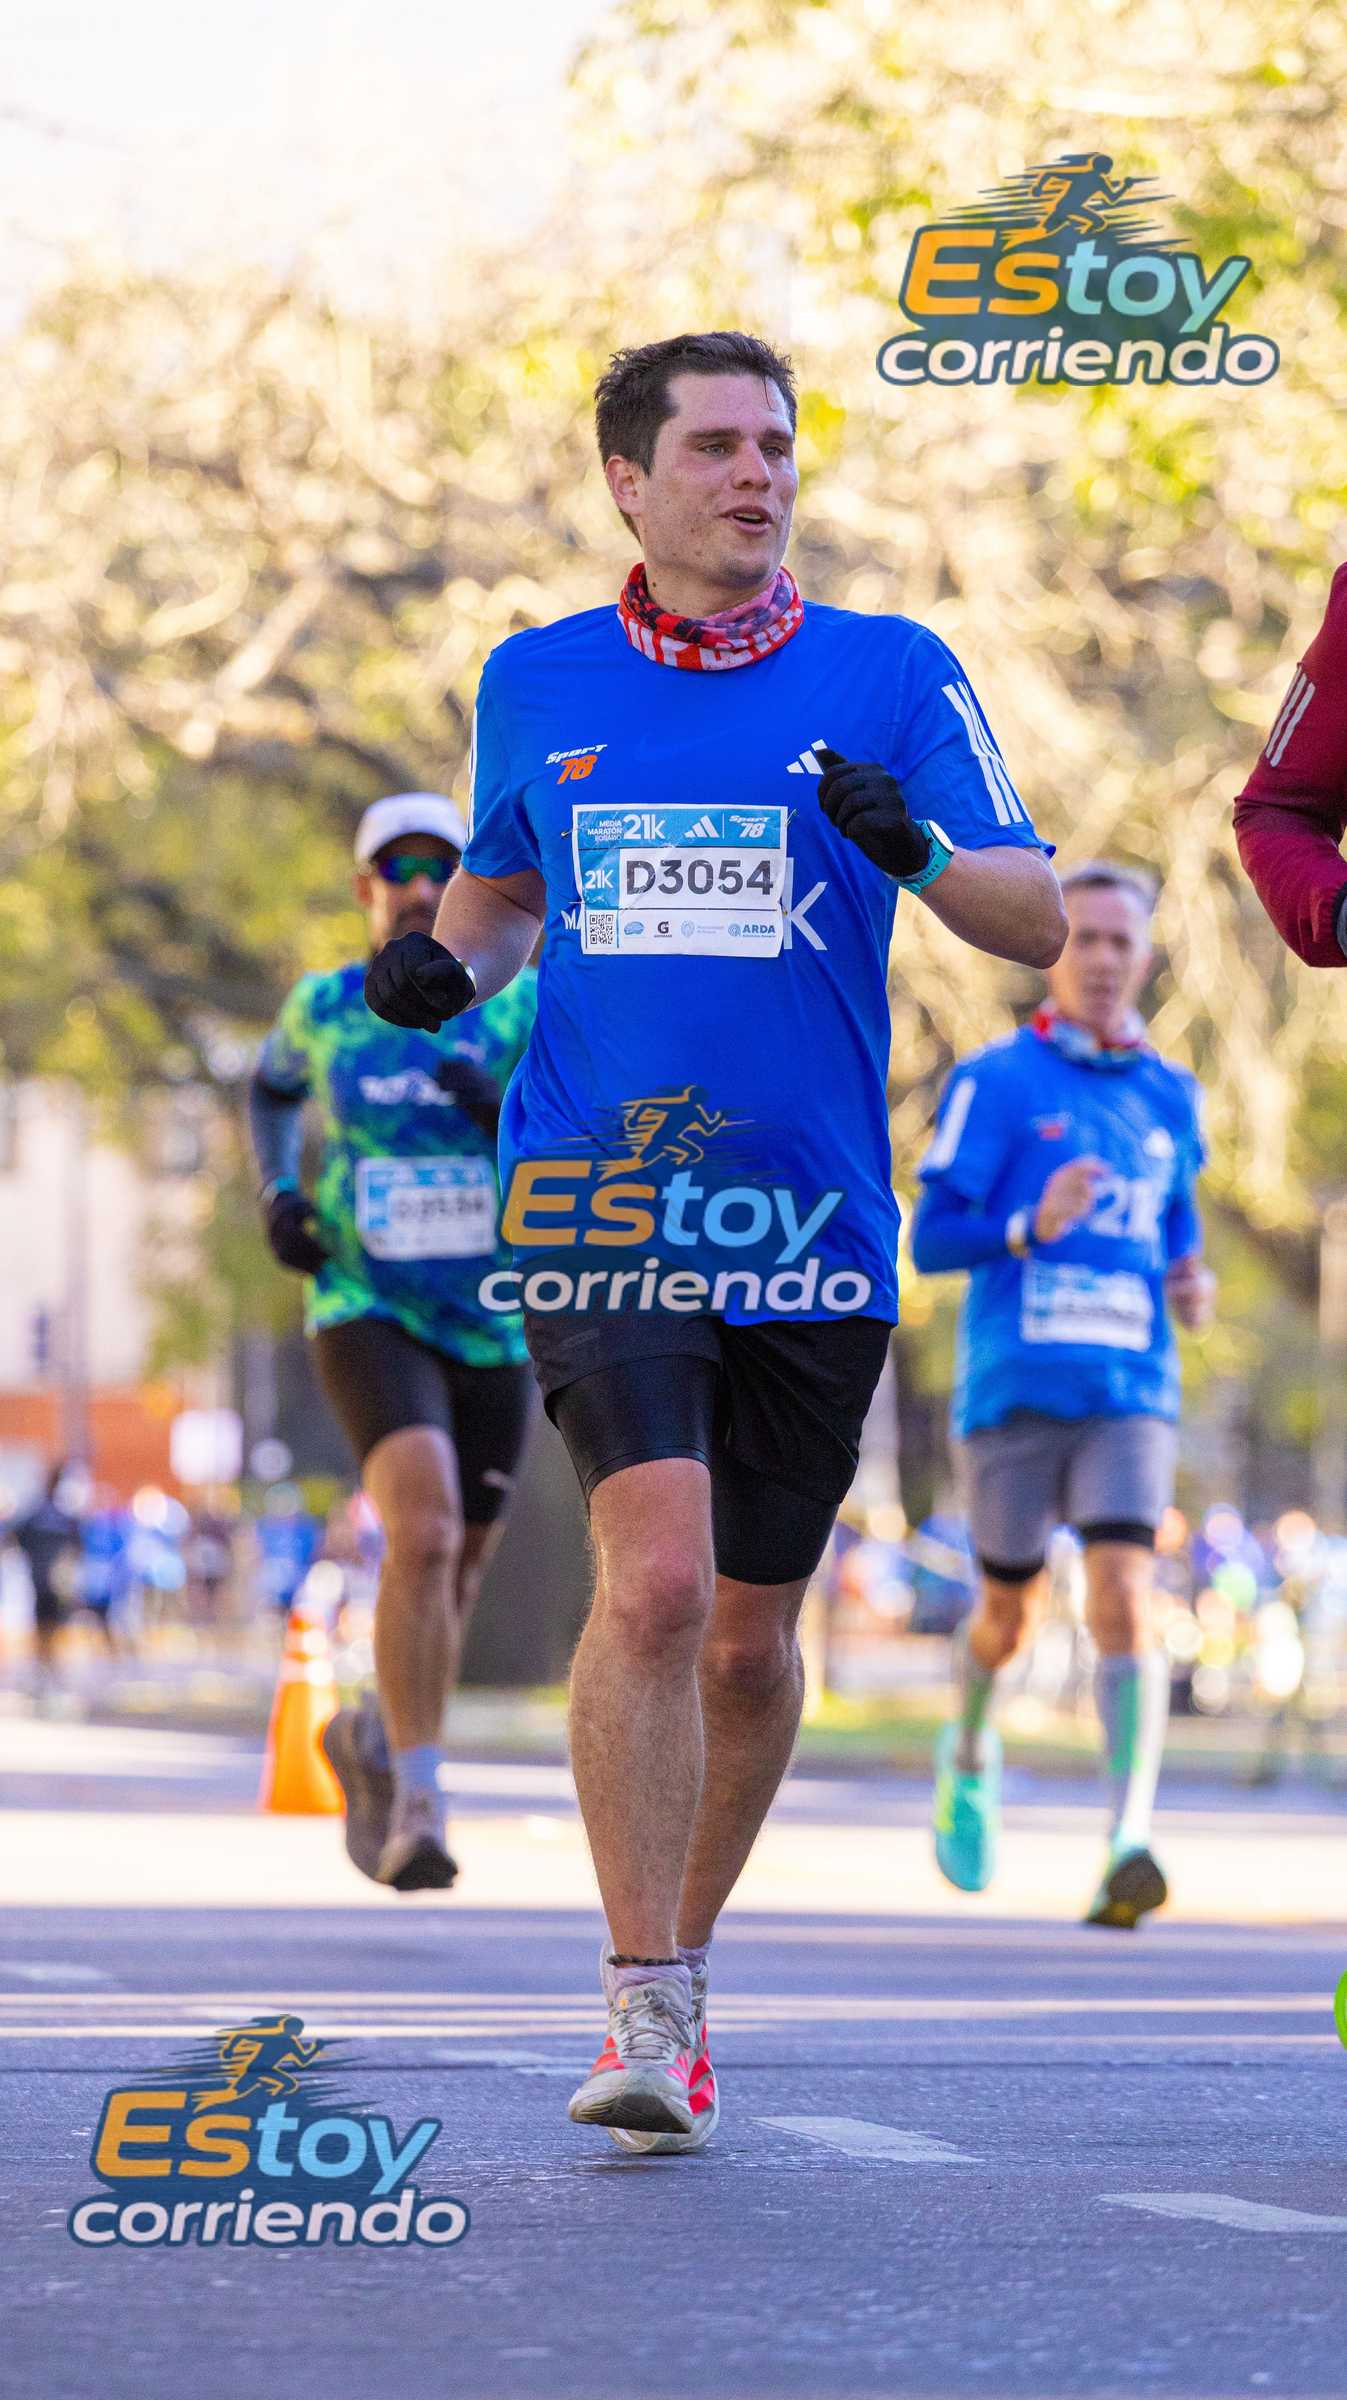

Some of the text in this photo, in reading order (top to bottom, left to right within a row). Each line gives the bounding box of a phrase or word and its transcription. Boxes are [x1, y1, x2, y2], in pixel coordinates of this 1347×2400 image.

[545, 744, 608, 765] Sport
[557, 754, 598, 785] 78
[599, 819, 622, 828] MEDIA
[739, 823, 766, 838] 78
[626, 859, 774, 895] D3054
[742, 924, 776, 934] ARDA
